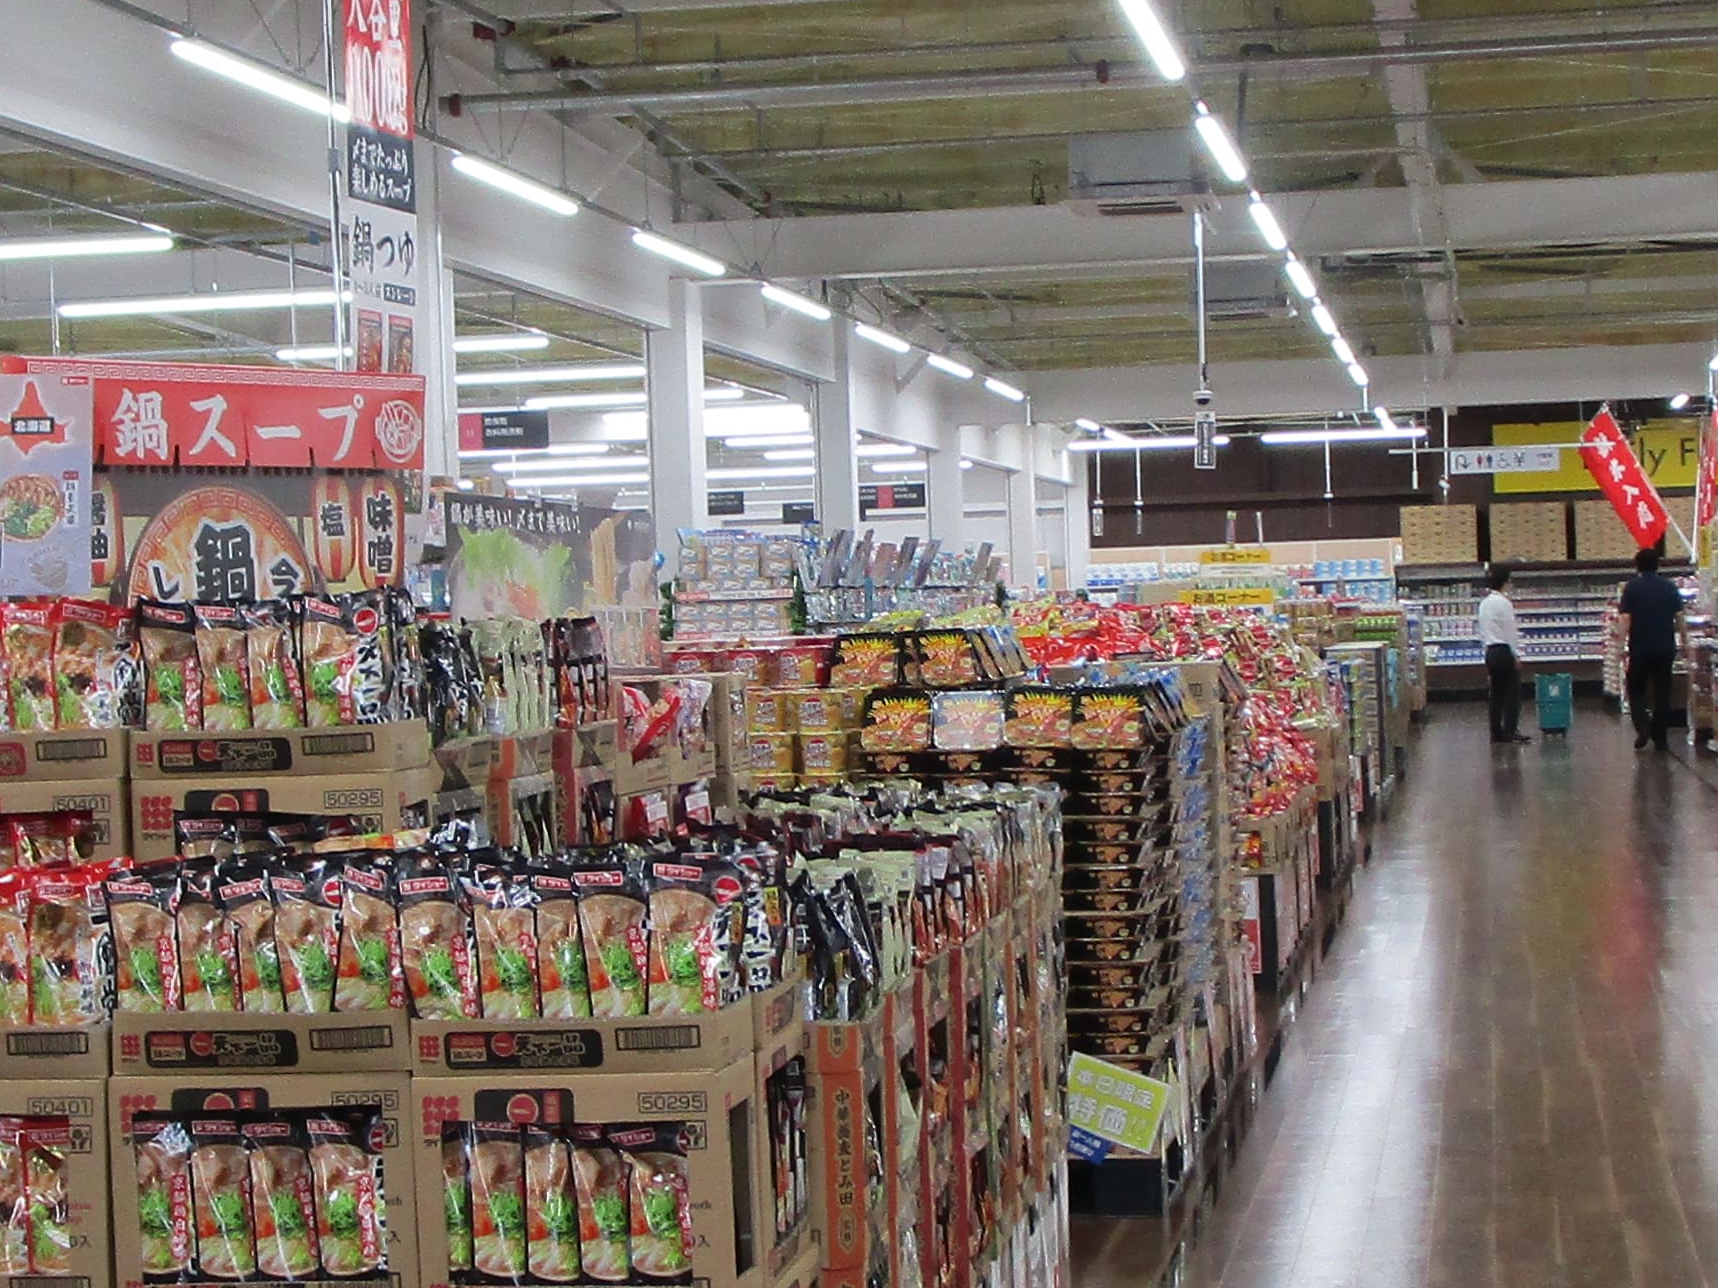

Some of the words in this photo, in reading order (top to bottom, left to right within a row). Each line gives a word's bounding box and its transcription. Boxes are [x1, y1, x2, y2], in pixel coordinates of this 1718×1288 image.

[351, 163, 413, 202] 楽しめるスープ
[352, 215, 415, 277] 鍋つゆ
[111, 387, 365, 461] 鍋スープ
[320, 502, 344, 538] 塩
[365, 491, 395, 575] 味噌
[194, 518, 252, 601] 鍋
[327, 791, 381, 808] 50295
[31, 1099, 91, 1115] 50401
[333, 1091, 398, 1108] 50295
[640, 1094, 705, 1112] 50295
